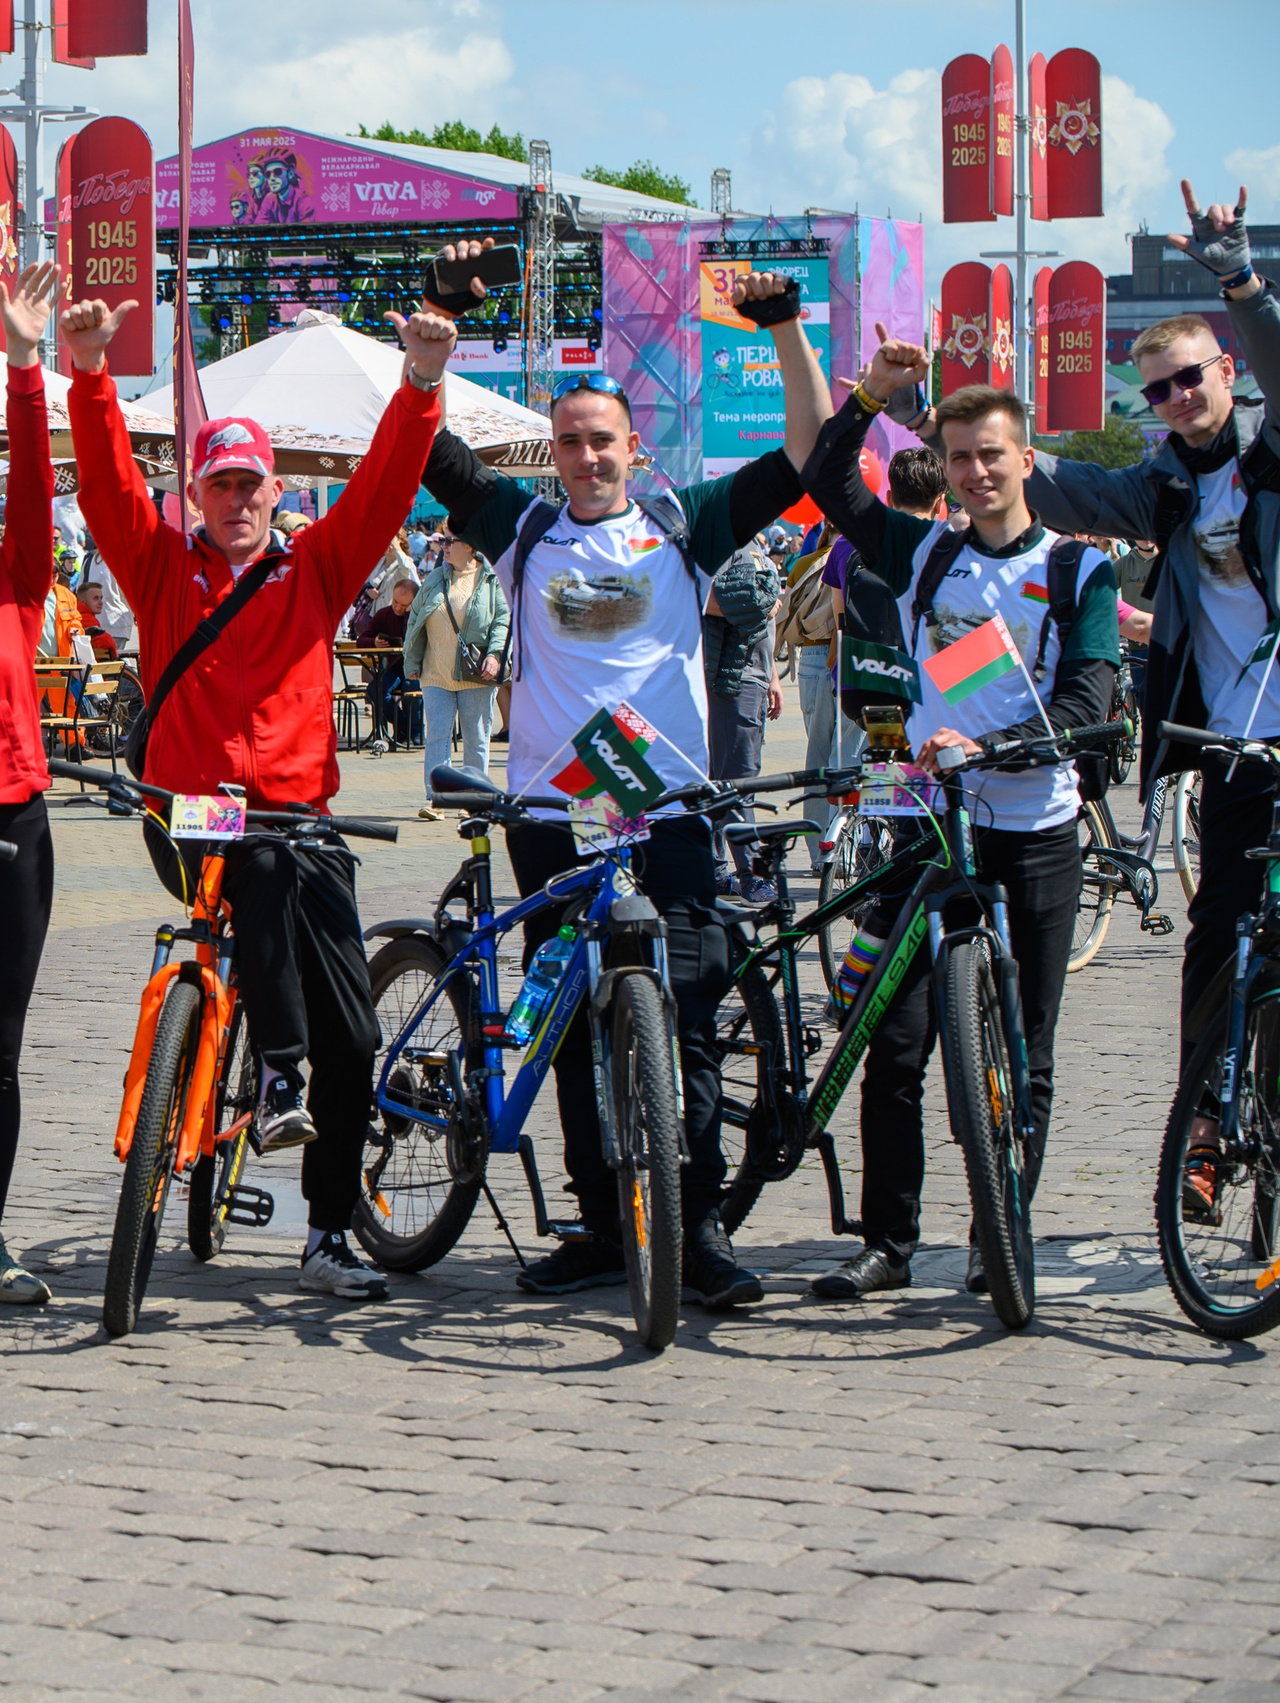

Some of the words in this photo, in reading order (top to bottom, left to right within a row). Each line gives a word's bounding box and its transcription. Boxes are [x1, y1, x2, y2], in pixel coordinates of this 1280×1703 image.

[239, 138, 250, 147] 31
[253, 137, 270, 147] МАЯ
[273, 136, 296, 146] 2025
[953, 123, 986, 143] 1945
[951, 147, 986, 166] 2025
[73, 169, 151, 214] Победа
[354, 181, 419, 201] VIVA
[88, 221, 137, 249] 1945
[85, 257, 137, 285] 2025
[713, 268, 736, 293] 31
[1059, 331, 1092, 350] 1945
[1057, 355, 1092, 374] 2025
[714, 412, 740, 422] Тема
[740, 430, 785, 441] Карнава
[852, 655, 913, 683] VOLAT
[590, 729, 647, 792] VOLAT
[532, 968, 588, 1078] AUTHOR
